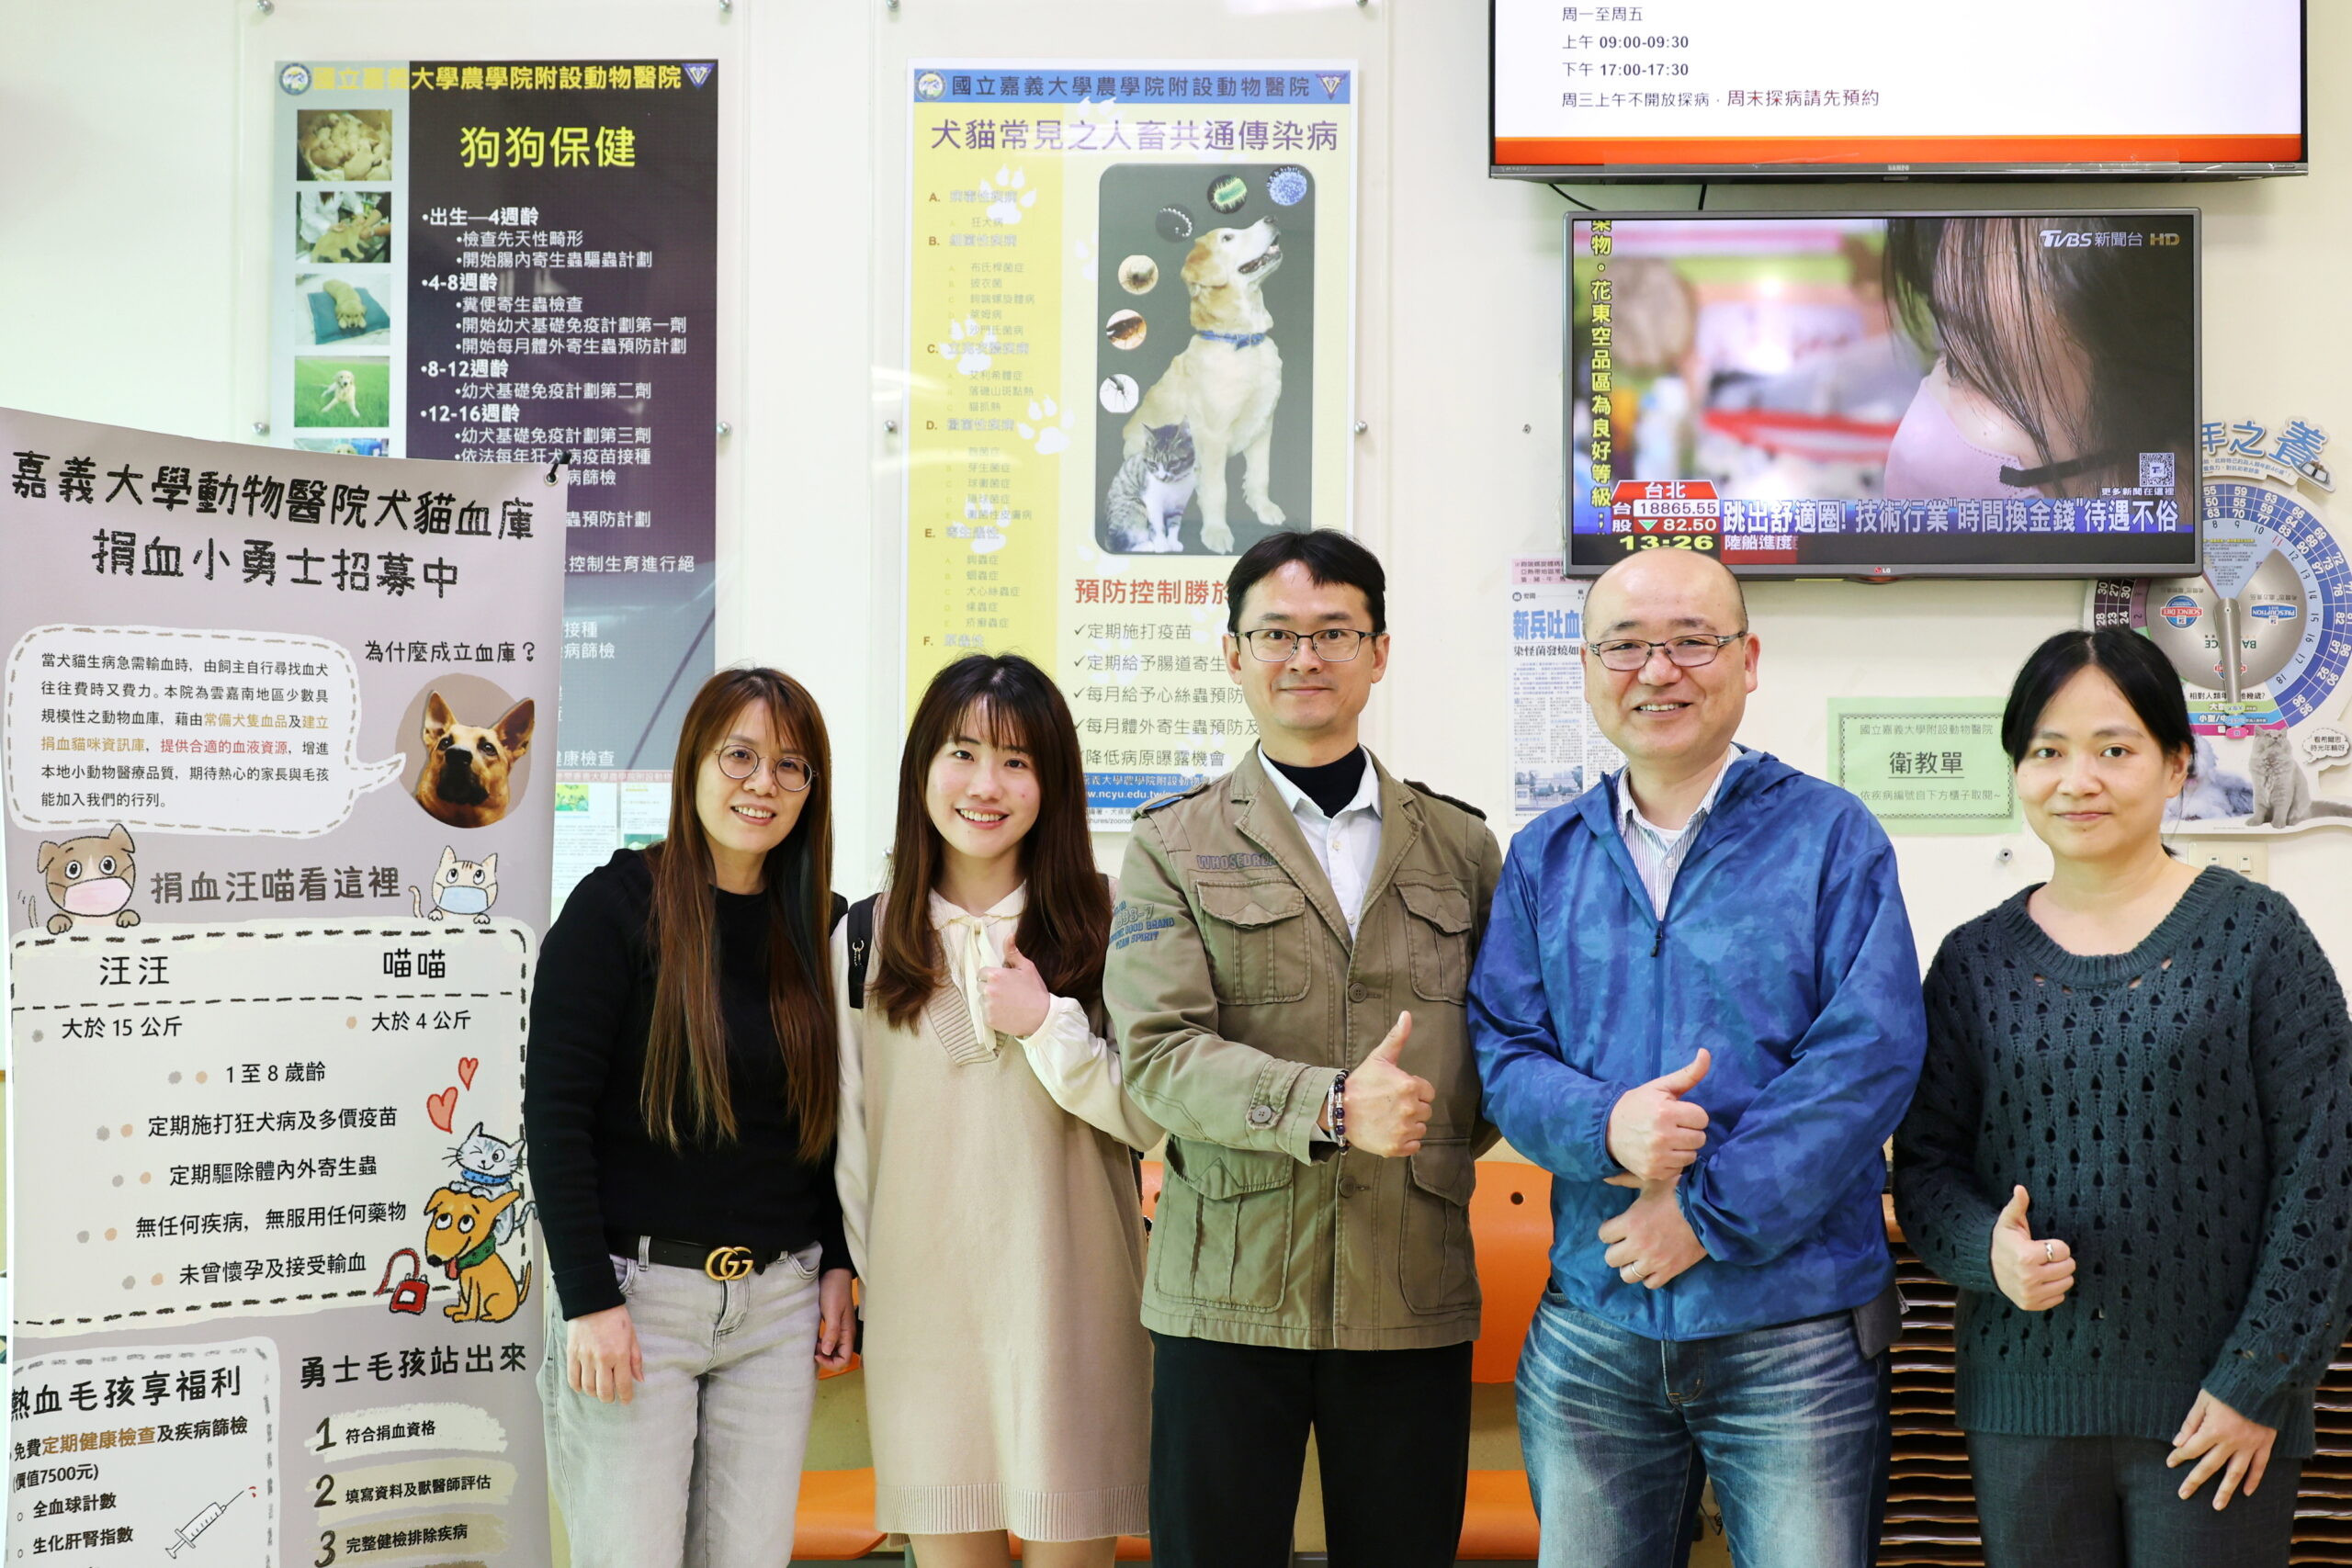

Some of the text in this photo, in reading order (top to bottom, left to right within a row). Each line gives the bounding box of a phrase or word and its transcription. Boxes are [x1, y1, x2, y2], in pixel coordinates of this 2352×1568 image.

[1563, 6, 1643, 21] 周一至周五
[1563, 35, 1689, 49] 上午 09:00-09:30
[1563, 62, 1689, 76] 下午 17:00-17:30
[951, 75, 1309, 97] 國立嘉義大學農學院附設動物醫院
[932, 119, 1338, 151] 犬貓常見之人畜共通傳染病
[459, 126, 636, 168] 狗狗保健
[929, 192, 940, 202] A.
[462, 231, 583, 247] 檢查先天性畸形
[929, 236, 940, 245] B.
[2040, 231, 2179, 247] TVBS 新聞台 HD
[462, 252, 652, 268] 開始腸內寄生蟲驅蟲計劃
[428, 275, 498, 292] 4-8週齡
[462, 297, 582, 313] 糞便寄生蟲檢查
[461, 318, 686, 334] 開始幼犬基礎免疫計劃第一劑
[461, 338, 687, 355] 開始每月體外寄生蟲預防計劃
[927, 344, 938, 354] C.
[427, 360, 509, 378] 8-12週齡
[461, 383, 651, 400] 幼犬基礎免疫計劃第二劑
[427, 404, 520, 423] 12-16週齡
[926, 421, 938, 430] D.
[460, 427, 651, 445] 幼犬基礎免疫計劃第三劑
[12, 450, 535, 541] 嘉義大學動物醫院犬貓血庫
[1645, 482, 1686, 499] 台北
[2203, 487, 2216, 495] 55
[2234, 487, 2247, 495] 59
[2265, 493, 2278, 502] 63
[1640, 502, 1716, 514] 18865.55
[2205, 498, 2218, 506] 50
[2233, 498, 2246, 506] 55
[2260, 503, 2273, 513] 59
[2207, 509, 2220, 518] 63
[2233, 510, 2245, 518] 70
[2257, 514, 2270, 525] 77
[2291, 507, 2305, 518] 66
[1663, 519, 1716, 532] 82.50
[2286, 516, 2298, 527] 64
[925, 529, 935, 537] E.
[2278, 524, 2291, 536] 83
[2315, 527, 2327, 540] 69
[1620, 536, 1714, 550] 13:26
[2297, 541, 2309, 554] 90
[2305, 534, 2318, 547] 68
[91, 528, 458, 599] 捐血小勇士招募中
[2324, 557, 2334, 570] 73
[2334, 552, 2344, 565] 72
[2098, 582, 2108, 595] 30
[2109, 583, 2120, 597] 27
[2120, 586, 2132, 599] 30
[1513, 610, 1580, 639] 新兵吐血
[2096, 613, 2105, 626] 28
[2108, 612, 2117, 625] 23
[2120, 611, 2129, 624] 24
[2335, 612, 2345, 625] 82
[564, 622, 597, 638] 接種
[1088, 624, 1192, 639] 定期施打疫苗
[2205, 640, 2256, 649] BACE
[2330, 639, 2340, 653] 87
[2341, 643, 2351, 657] 86
[1088, 656, 1226, 671] 定期給予腸道寄生
[2317, 666, 2329, 680] 92
[1088, 687, 1243, 704] 每月給予心絲蟲預防
[2292, 694, 2306, 706] 96
[2300, 703, 2312, 716] 95
[1086, 718, 1259, 735] 每月體外寄生蟲預防及
[1860, 724, 1993, 735] 國立嘉義大學附設動物醫院
[1086, 750, 1225, 767] 降低病原曝露機會
[1890, 751, 1962, 774] 衛教單
[41, 793, 165, 807] 能加入我們的行列。
[151, 866, 401, 905] 捐血汪喵看這裡
[1147, 918, 1174, 930] BRAND
[1131, 931, 1159, 943] SPIRIT
[99, 955, 170, 987] 汪汪
[383, 948, 447, 979] 喵喵
[62, 1016, 183, 1040] 大於 15 公斤
[371, 1010, 471, 1033] 大於 4 公斤
[226, 1062, 326, 1085] 1 至 8 歲齡
[148, 1107, 398, 1138] 定期施打狂犬病及多價疫苗
[169, 1156, 378, 1187] 定期驅除體內外寄生蟲
[136, 1202, 407, 1239] 無任何疾病，無服用任何藥物
[179, 1252, 367, 1286] 未曾懷孕及接受輸血
[300, 1342, 526, 1389] 勇士毛孩站出來
[11, 1365, 241, 1422] 熱血毛孩享福利
[15, 1416, 248, 1461] 免費定期健康檢查及疾病篩檢
[316, 1416, 435, 1451] 1 符合捐血資格
[13, 1464, 99, 1494] (價值7500元)
[314, 1474, 492, 1507] 2 填寫資料及獸醫師評估
[33, 1492, 117, 1518] 全血球計數
[33, 1527, 134, 1554] 生化肝腎指數
[314, 1524, 468, 1568] 3 完整健檢排除疾病
